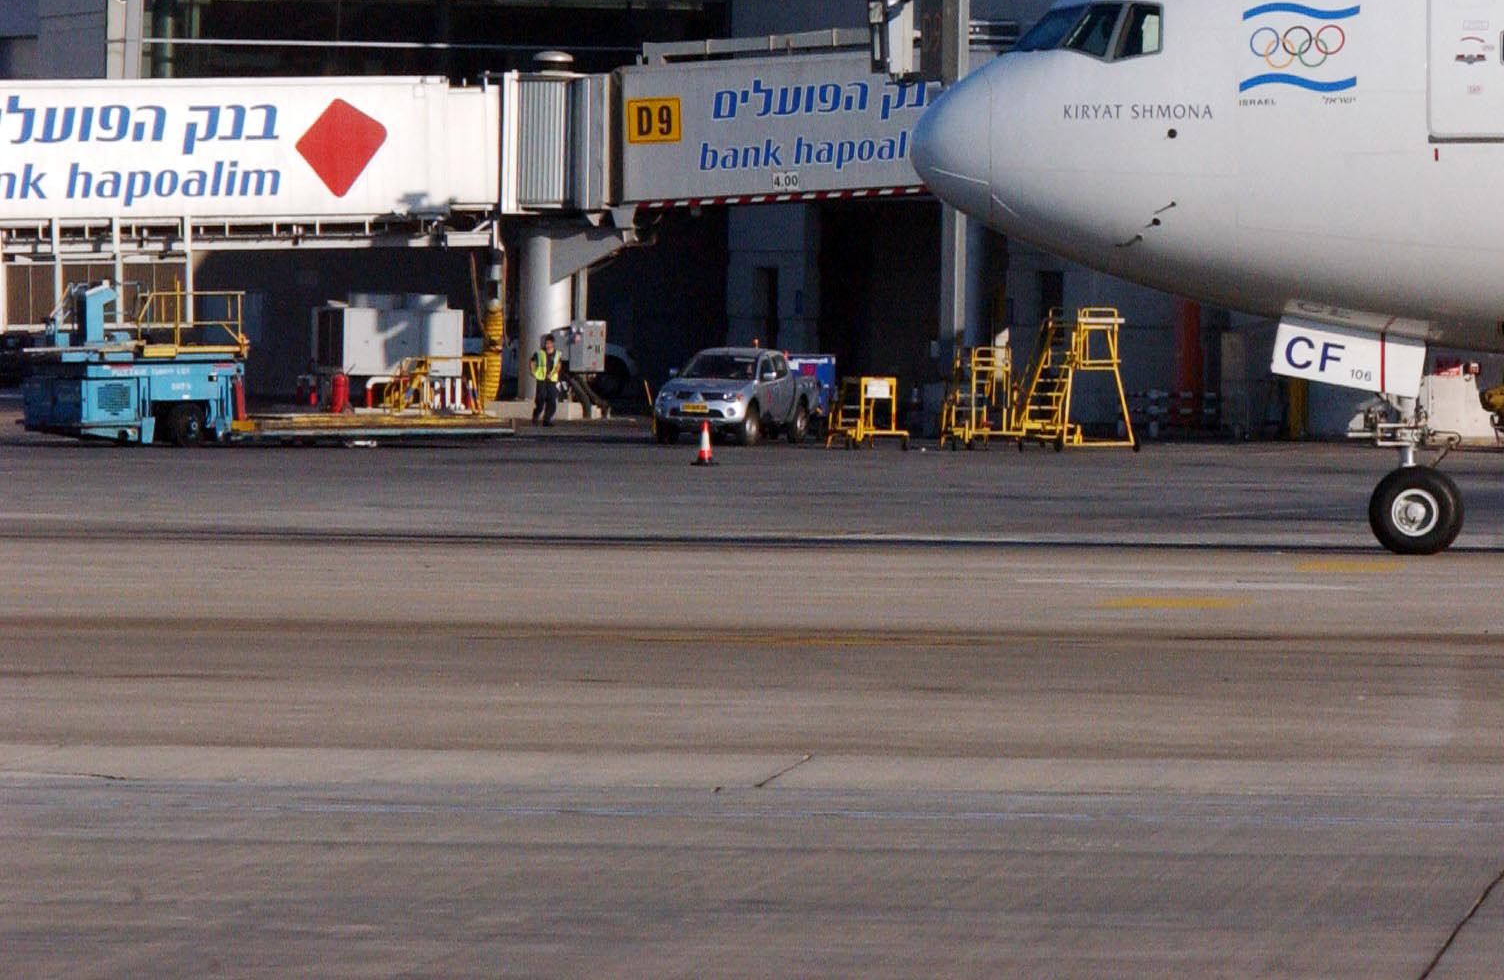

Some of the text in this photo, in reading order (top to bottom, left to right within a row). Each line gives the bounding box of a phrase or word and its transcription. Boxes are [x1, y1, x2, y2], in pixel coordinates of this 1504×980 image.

[712, 79, 934, 120] נק הפועלים
[1063, 104, 1213, 120] KIRYAT SHMONA
[1239, 98, 1277, 107] ISRAEL
[0, 95, 280, 155] בנק הפועל
[700, 139, 783, 171] bank
[66, 160, 281, 207] hapoalim
[1285, 336, 1346, 373] CF
[1350, 368, 1373, 382] 106
